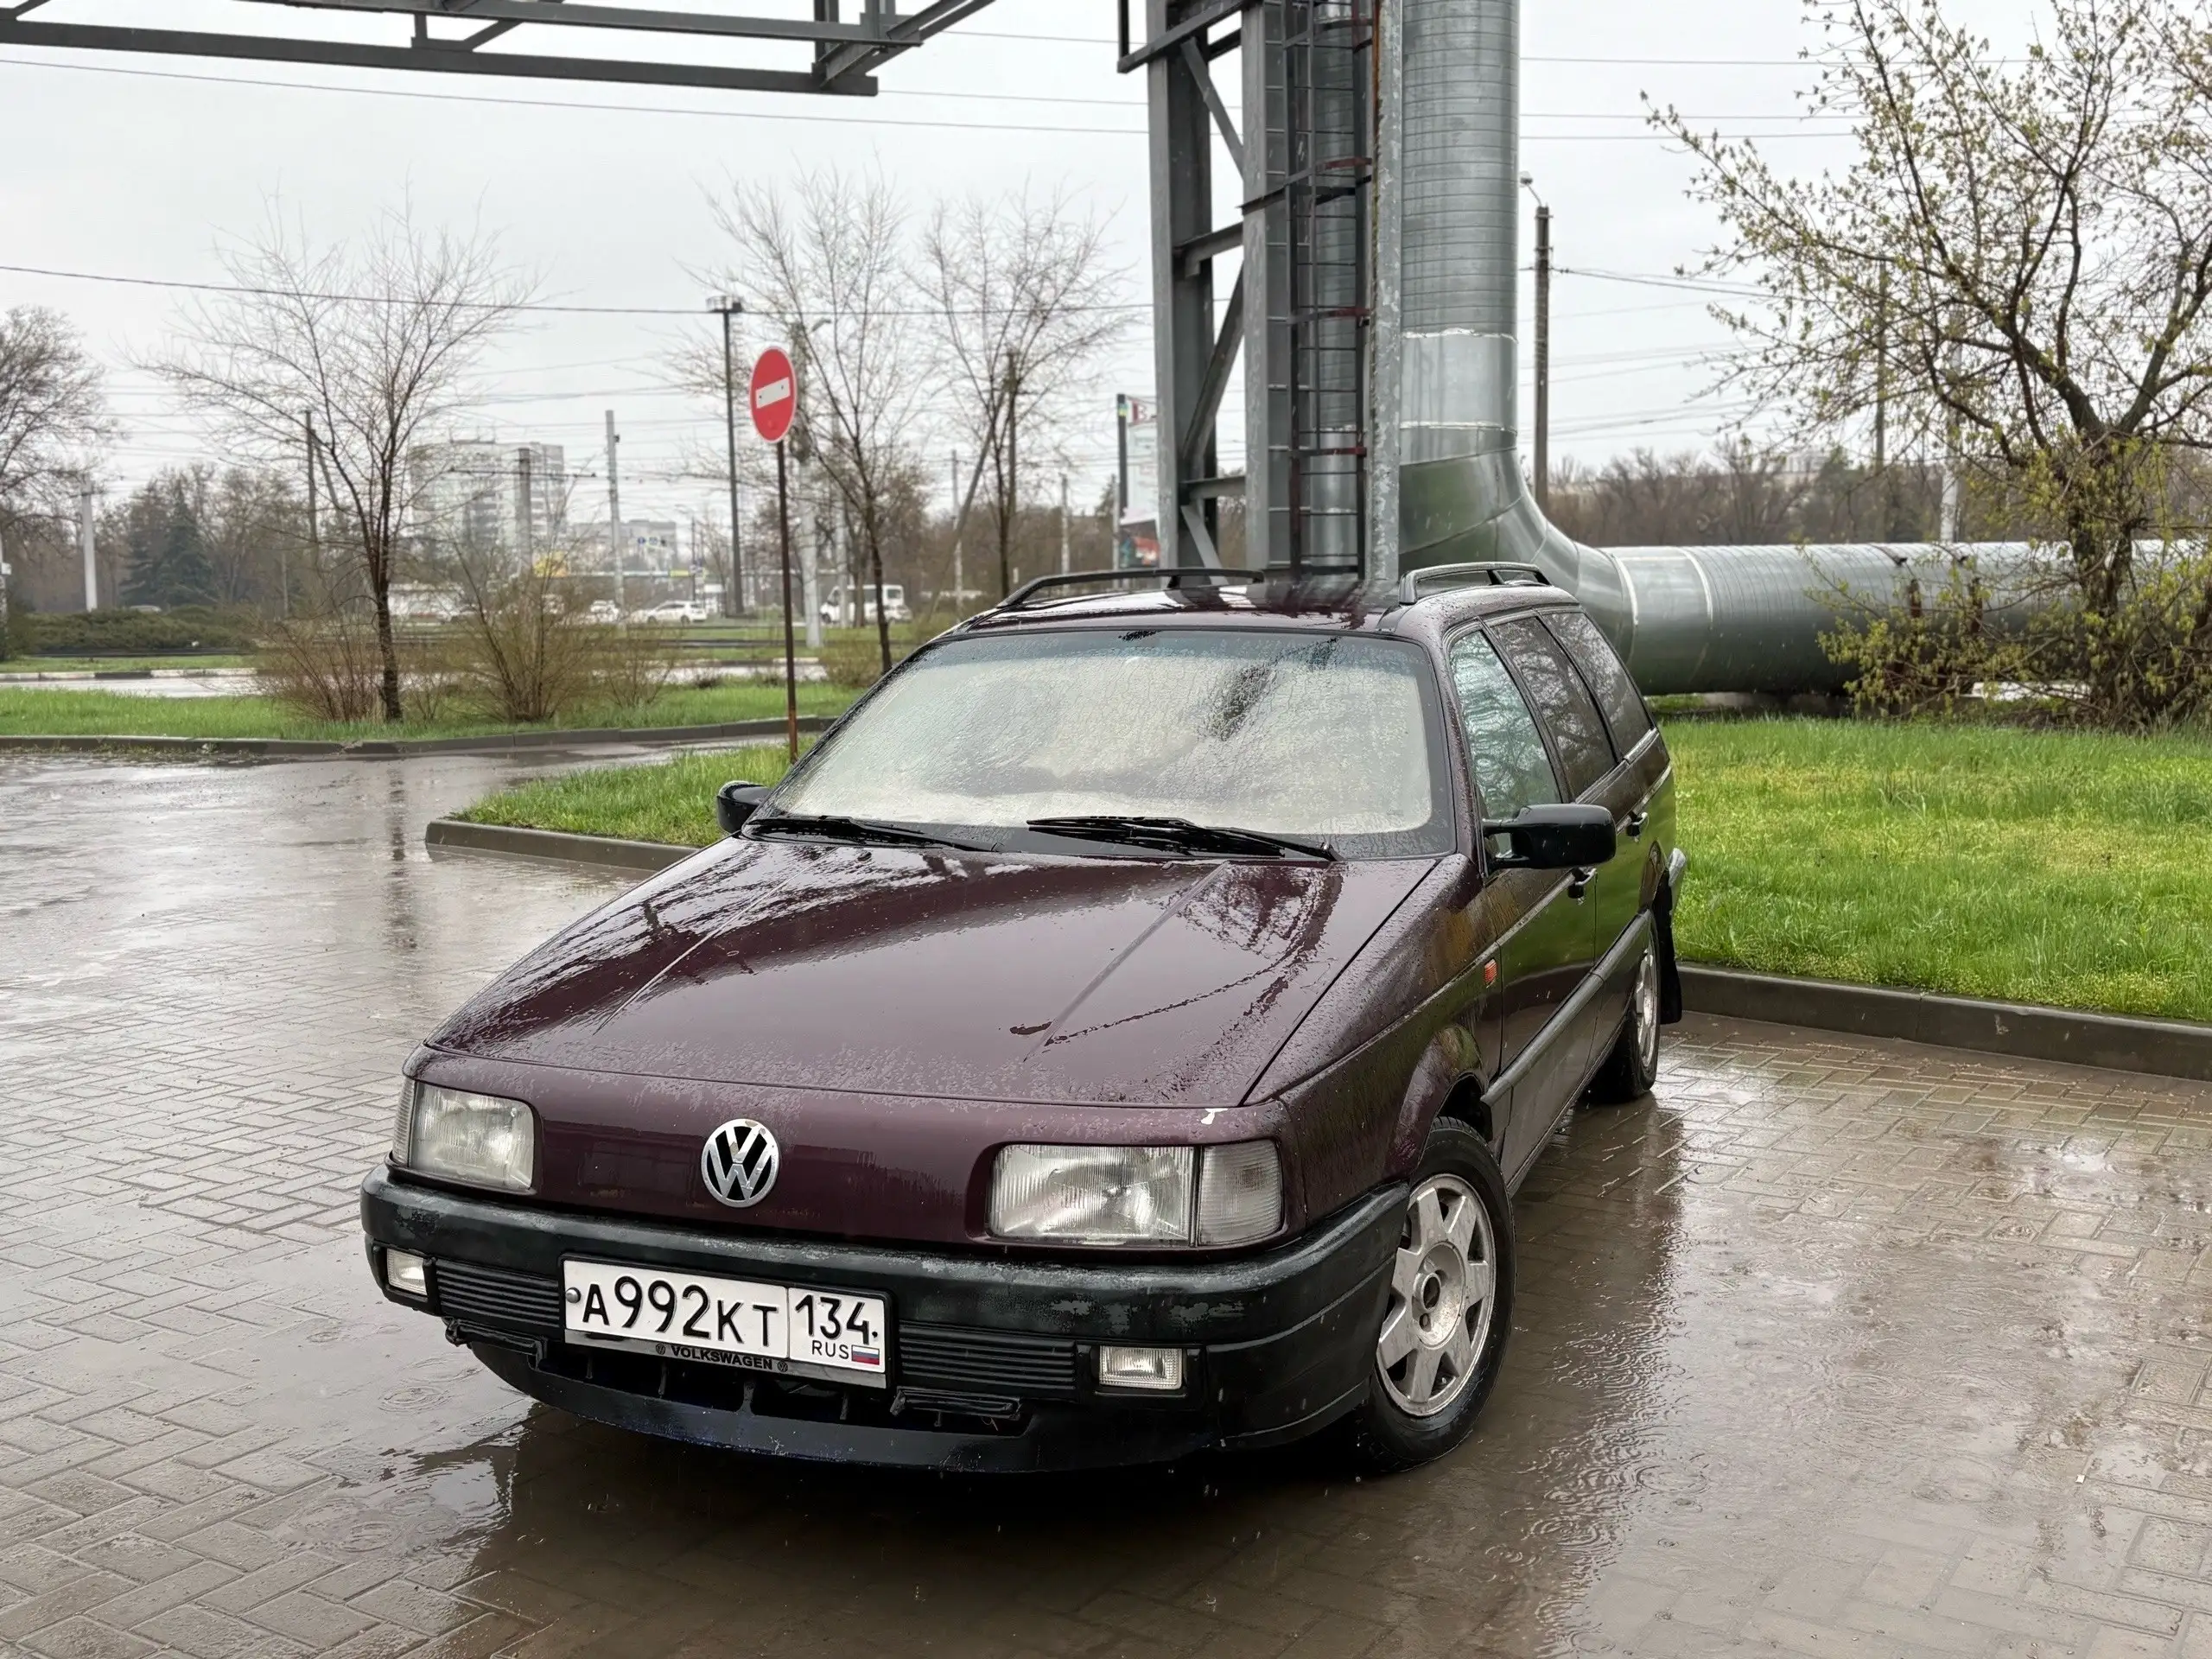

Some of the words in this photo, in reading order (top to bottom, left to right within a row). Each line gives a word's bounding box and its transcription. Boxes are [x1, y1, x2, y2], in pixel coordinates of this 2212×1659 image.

[702, 1118, 779, 1208] VW
[582, 1275, 778, 1347] A992KT
[795, 1294, 870, 1345] 134
[671, 1344, 772, 1370] VOLKSWAGEN
[811, 1339, 849, 1360] RUS
